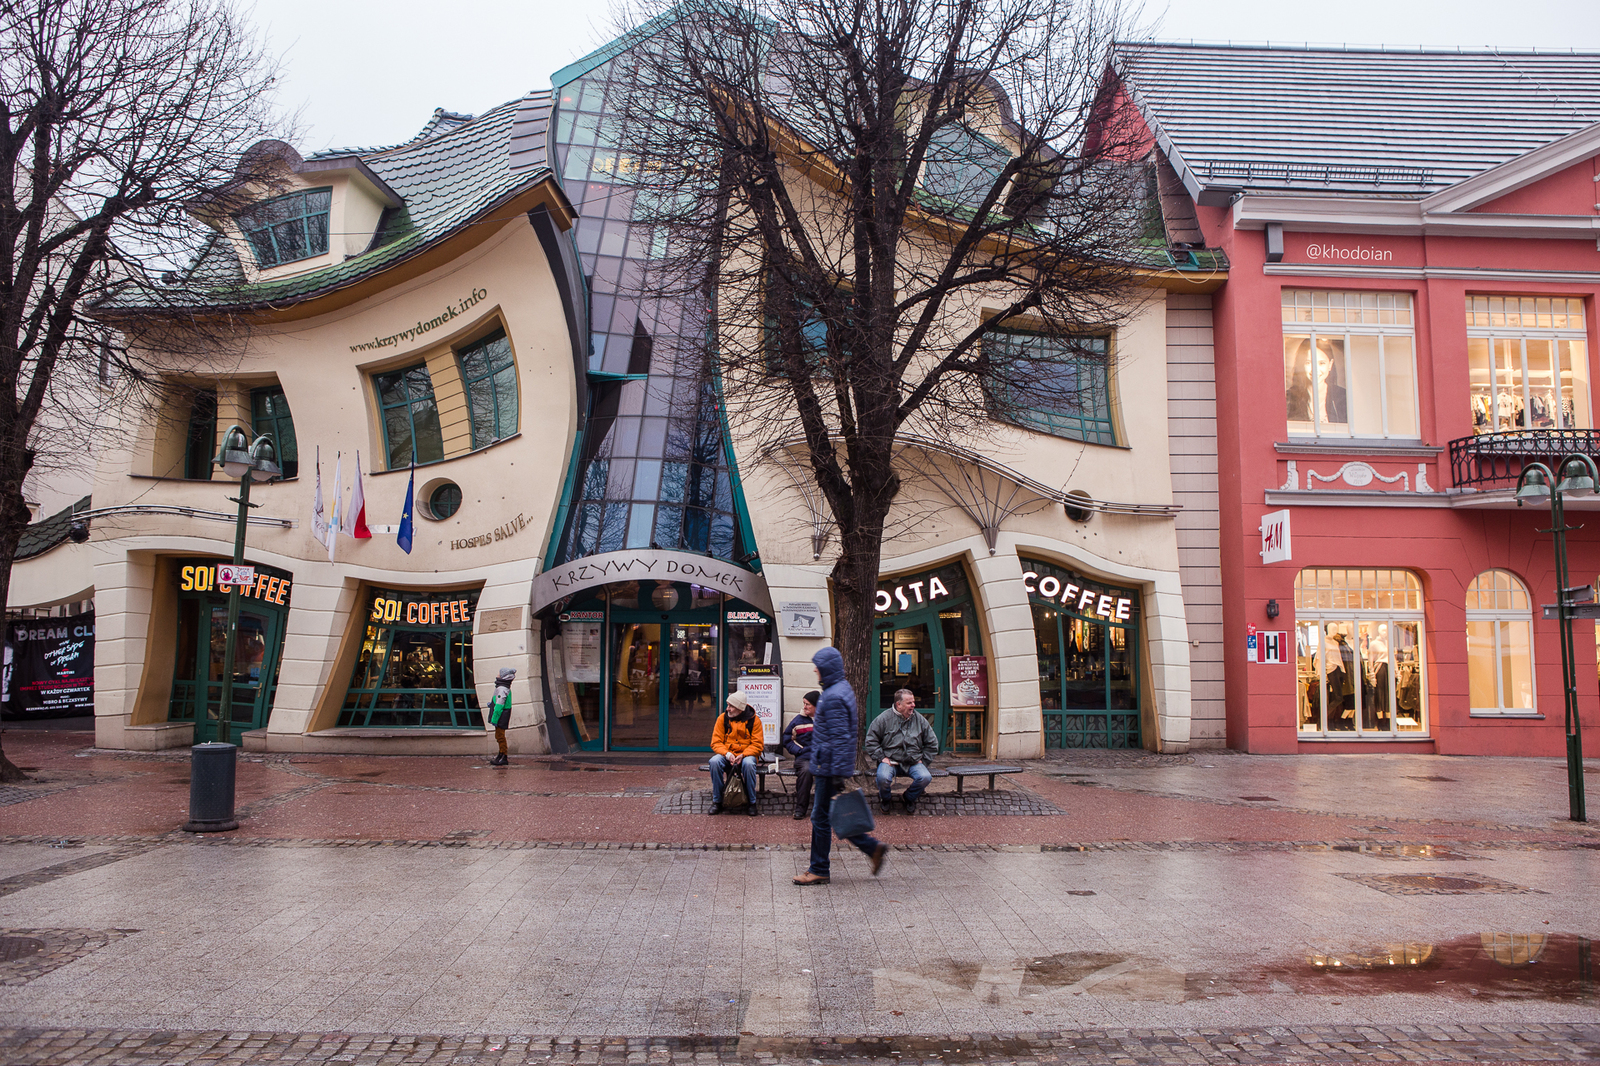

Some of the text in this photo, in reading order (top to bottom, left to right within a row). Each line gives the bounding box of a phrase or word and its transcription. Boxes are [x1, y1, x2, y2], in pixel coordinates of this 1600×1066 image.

[350, 288, 487, 352] www.krzywydomek.info
[451, 533, 492, 550] HOSPES
[1264, 521, 1282, 552] H&M
[181, 566, 215, 591] SO!
[220, 573, 290, 606] FFEE
[552, 558, 743, 592] KRZYWY DOMEK
[875, 576, 949, 612] OSTA
[1023, 571, 1131, 620] COFFEE
[373, 597, 402, 621] SO!
[407, 600, 470, 624] COFFEE
[570, 611, 604, 619] KANTOR
[18, 627, 68, 641] DREAM
[1266, 635, 1278, 659] H
